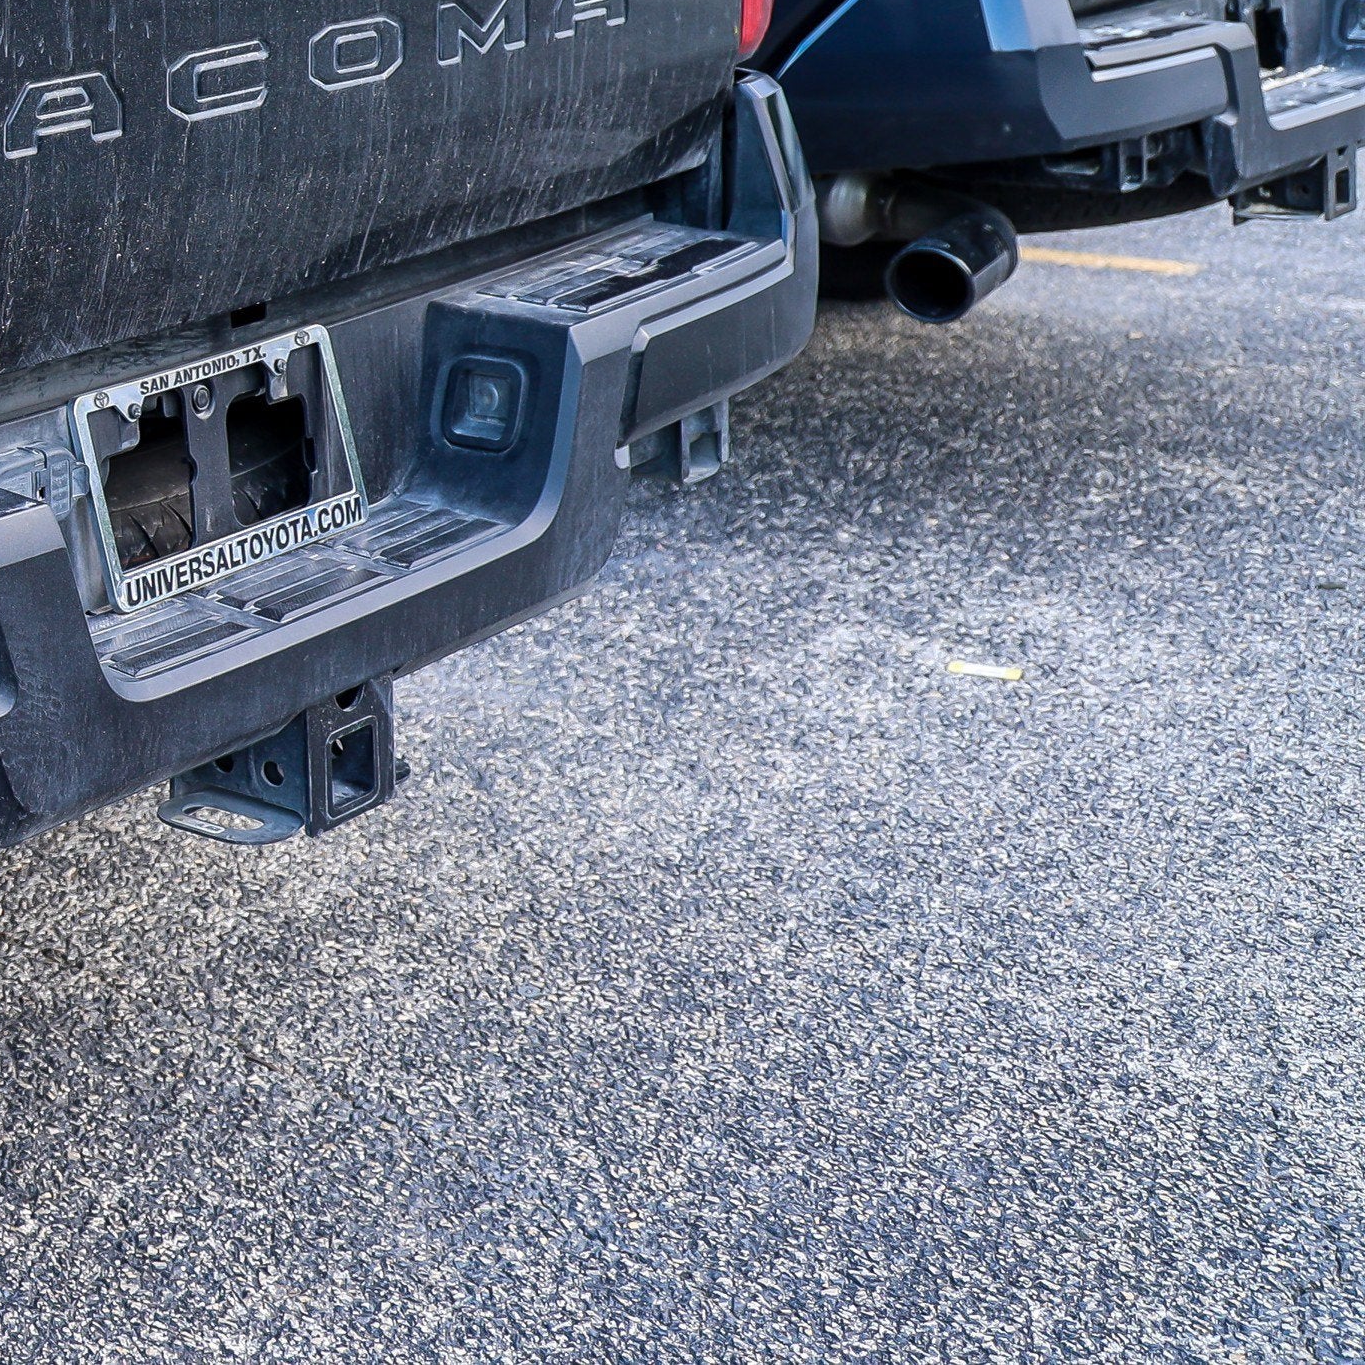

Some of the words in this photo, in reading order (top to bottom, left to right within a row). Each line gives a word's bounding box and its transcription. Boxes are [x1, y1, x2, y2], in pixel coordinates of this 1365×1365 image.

[139, 374, 170, 396] SAN
[173, 354, 241, 386] ANTONIO,
[242, 345, 267, 364] TX.
[124, 495, 364, 607] UNIVERSALTOYOTA.COM
